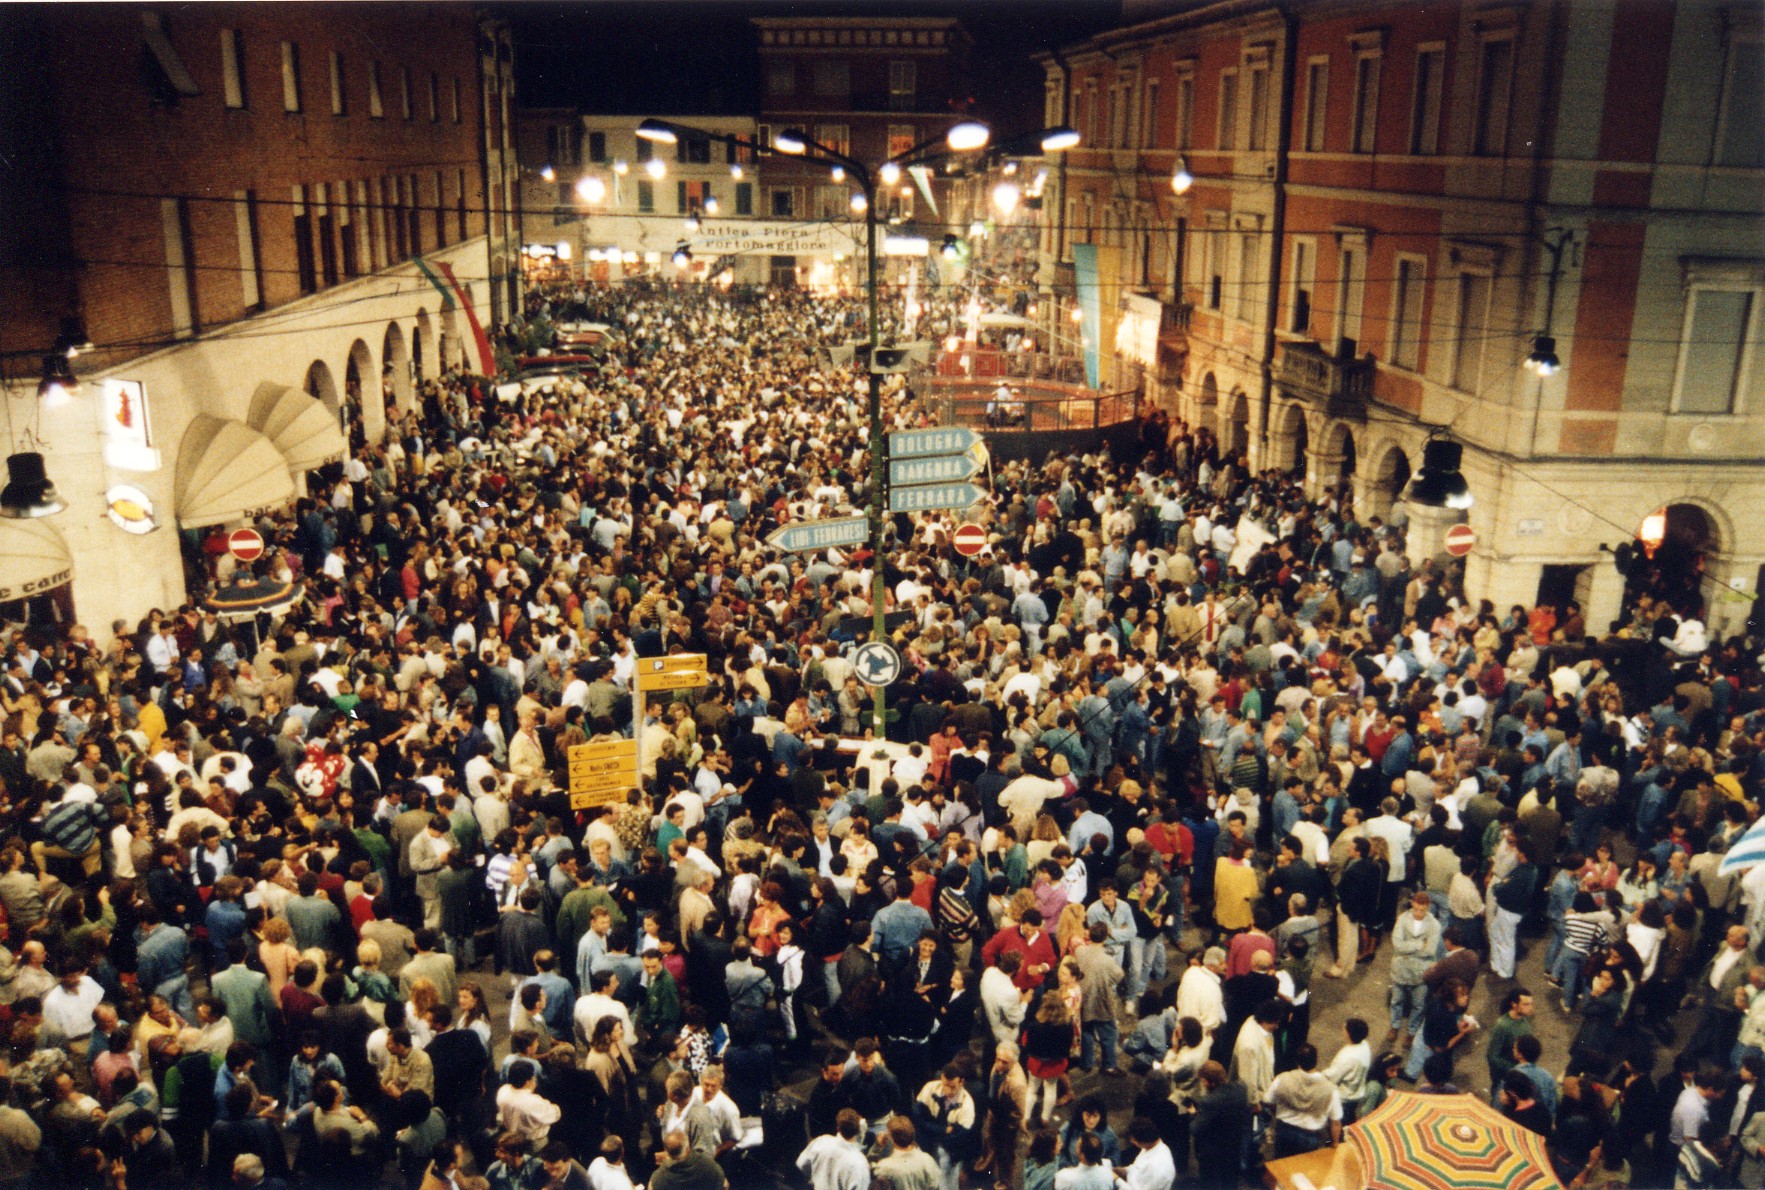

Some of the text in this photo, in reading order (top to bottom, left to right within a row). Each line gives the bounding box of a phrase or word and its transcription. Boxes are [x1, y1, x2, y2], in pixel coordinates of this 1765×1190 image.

[706, 239, 827, 251] Portomaggiore
[897, 432, 963, 452] BOLOGNA
[897, 460, 962, 478] RAVENNA
[897, 488, 966, 508] FERRARA
